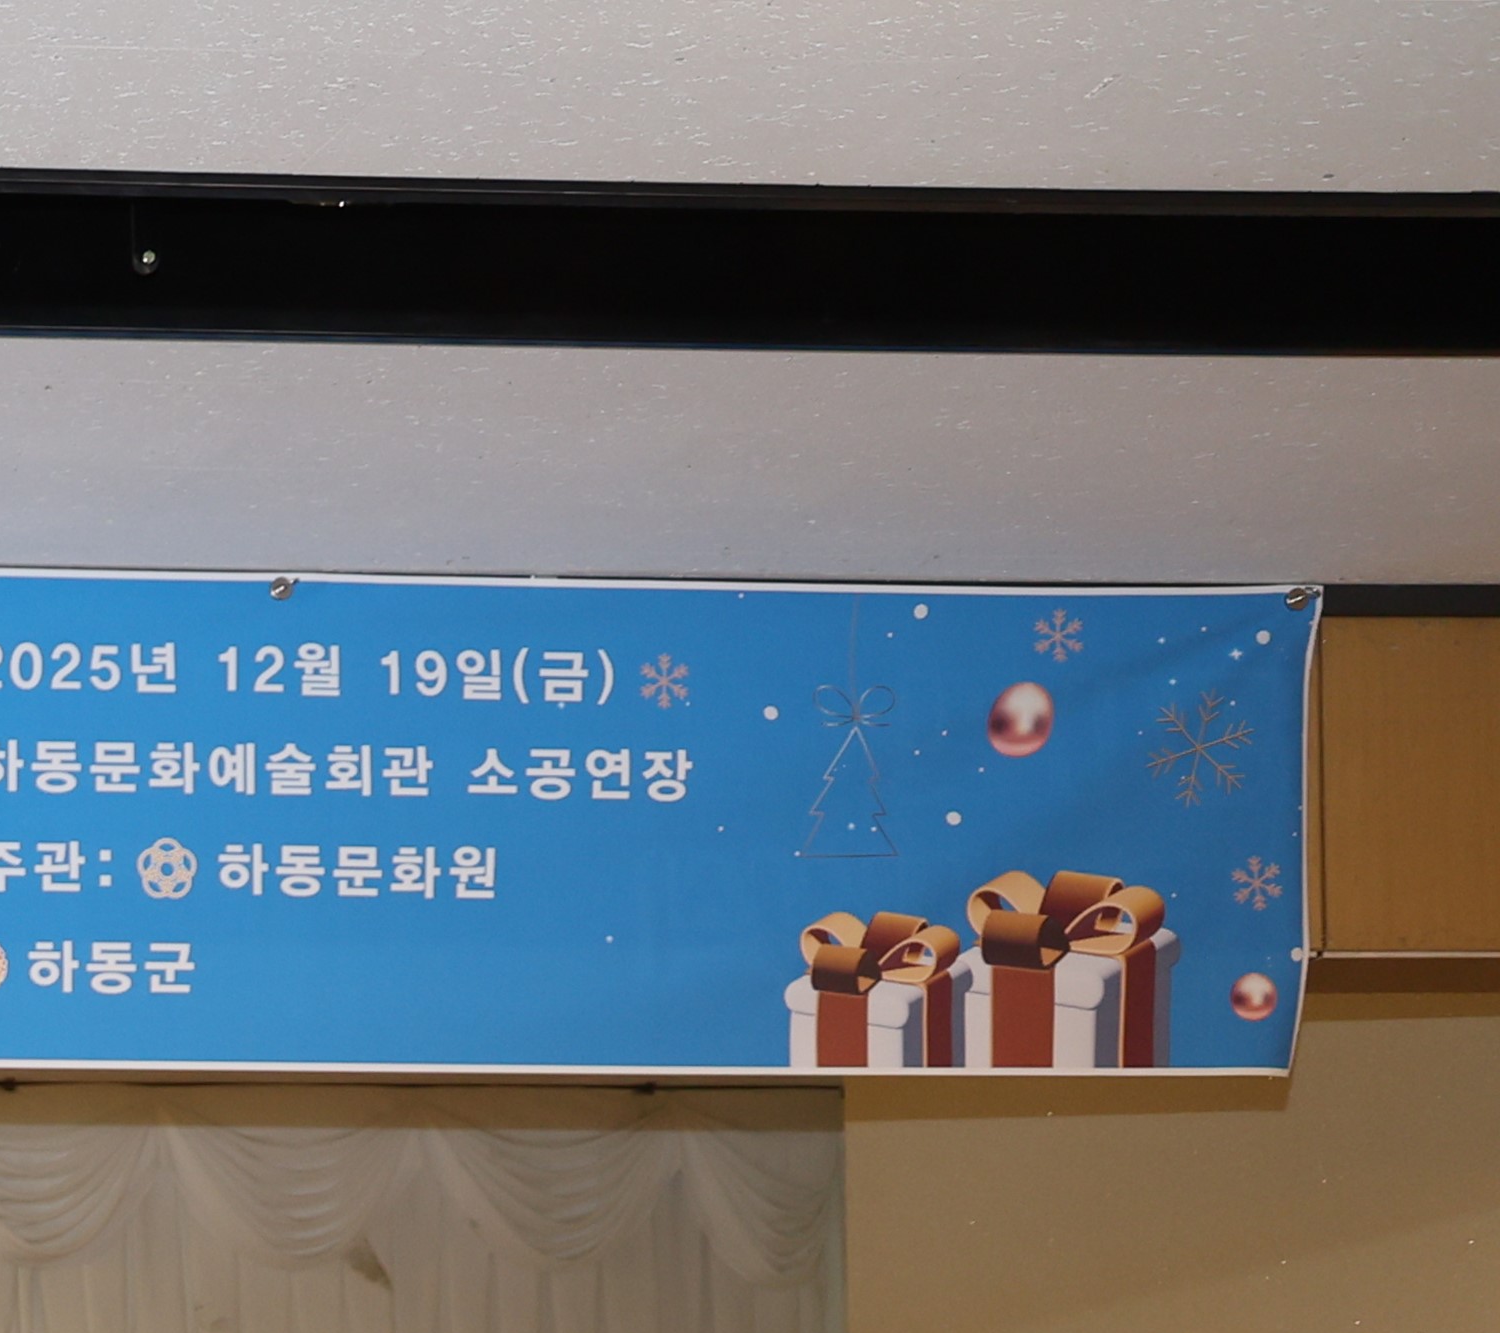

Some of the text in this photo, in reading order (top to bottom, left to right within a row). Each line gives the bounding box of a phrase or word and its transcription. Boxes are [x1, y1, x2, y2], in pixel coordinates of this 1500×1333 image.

[219, 643, 340, 697] 12월
[381, 647, 614, 705] 19일(금)
[467, 748, 693, 802] 소공연장
[218, 843, 496, 899] 하동문화원
[27, 940, 195, 995] 하동군
